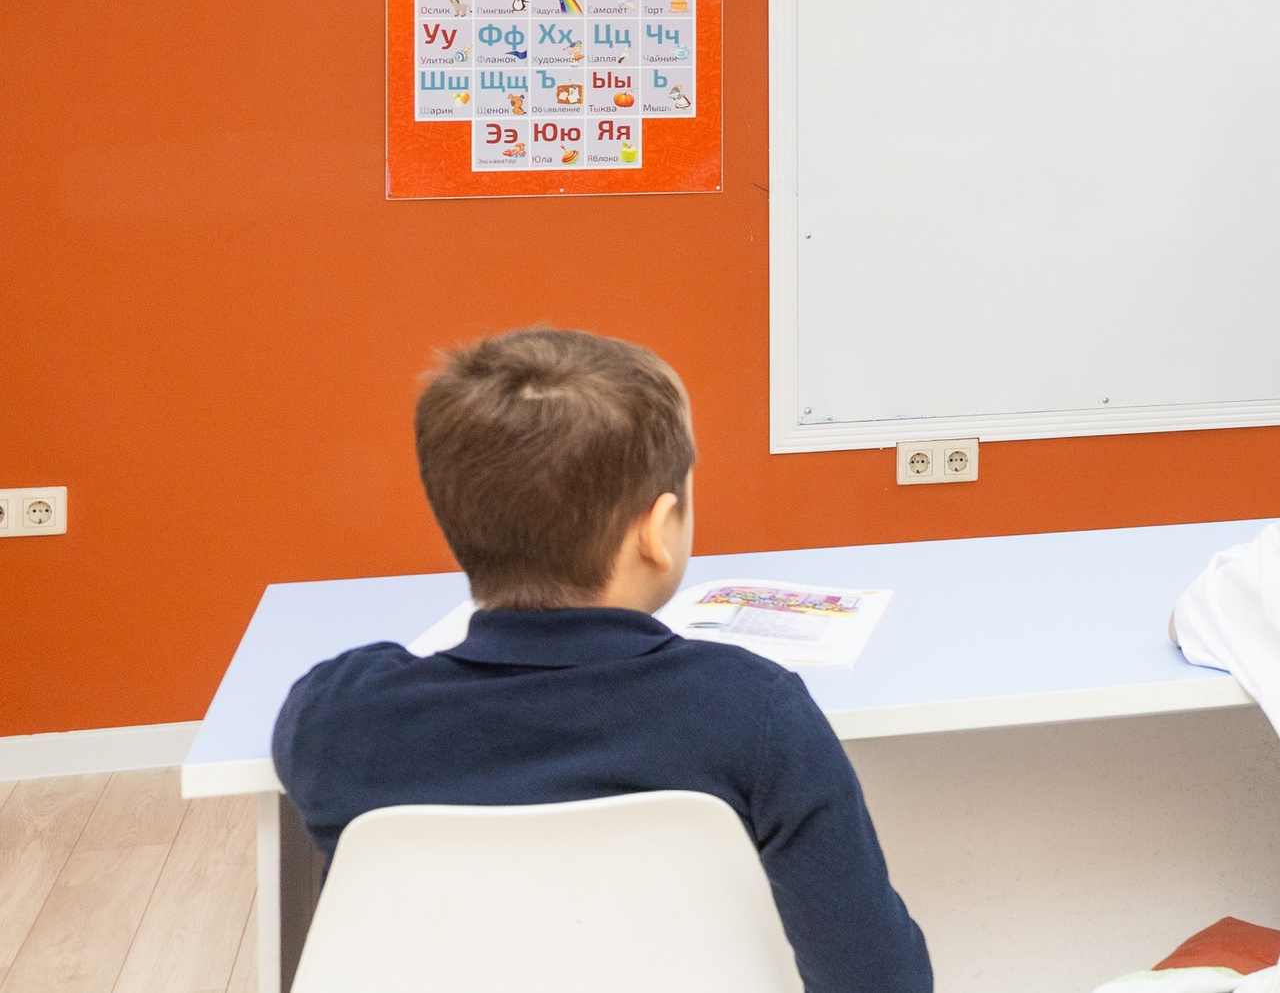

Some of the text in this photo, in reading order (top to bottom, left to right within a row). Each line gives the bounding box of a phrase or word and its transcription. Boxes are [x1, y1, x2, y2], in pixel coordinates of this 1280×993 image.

[531, 7, 560, 16] Радуга
[643, 6, 664, 16] Торт
[422, 23, 457, 50] Уу
[478, 23, 525, 50] Фф
[538, 23, 573, 44] Хх
[594, 24, 632, 48] Цц
[646, 24, 679, 44] Чч
[420, 56, 454, 64] Улитка
[477, 55, 516, 64] Флажок
[587, 55, 616, 64] Цапля
[642, 54, 678, 63] Чайник
[421, 71, 469, 90] Шш
[480, 71, 528, 93] Щщ
[536, 70, 556, 89] Ъ
[592, 71, 632, 88] Ыы
[653, 69, 668, 88] Ь
[420, 107, 453, 116] Шарик
[477, 107, 510, 115] Щенок
[588, 104, 617, 113] Тыква
[642, 104, 672, 112] Мышь
[486, 123, 518, 144] Ээ
[533, 122, 581, 142] Юю
[597, 120, 631, 140] Яя
[531, 155, 553, 164] Юла
[587, 155, 619, 163] Яблоко
